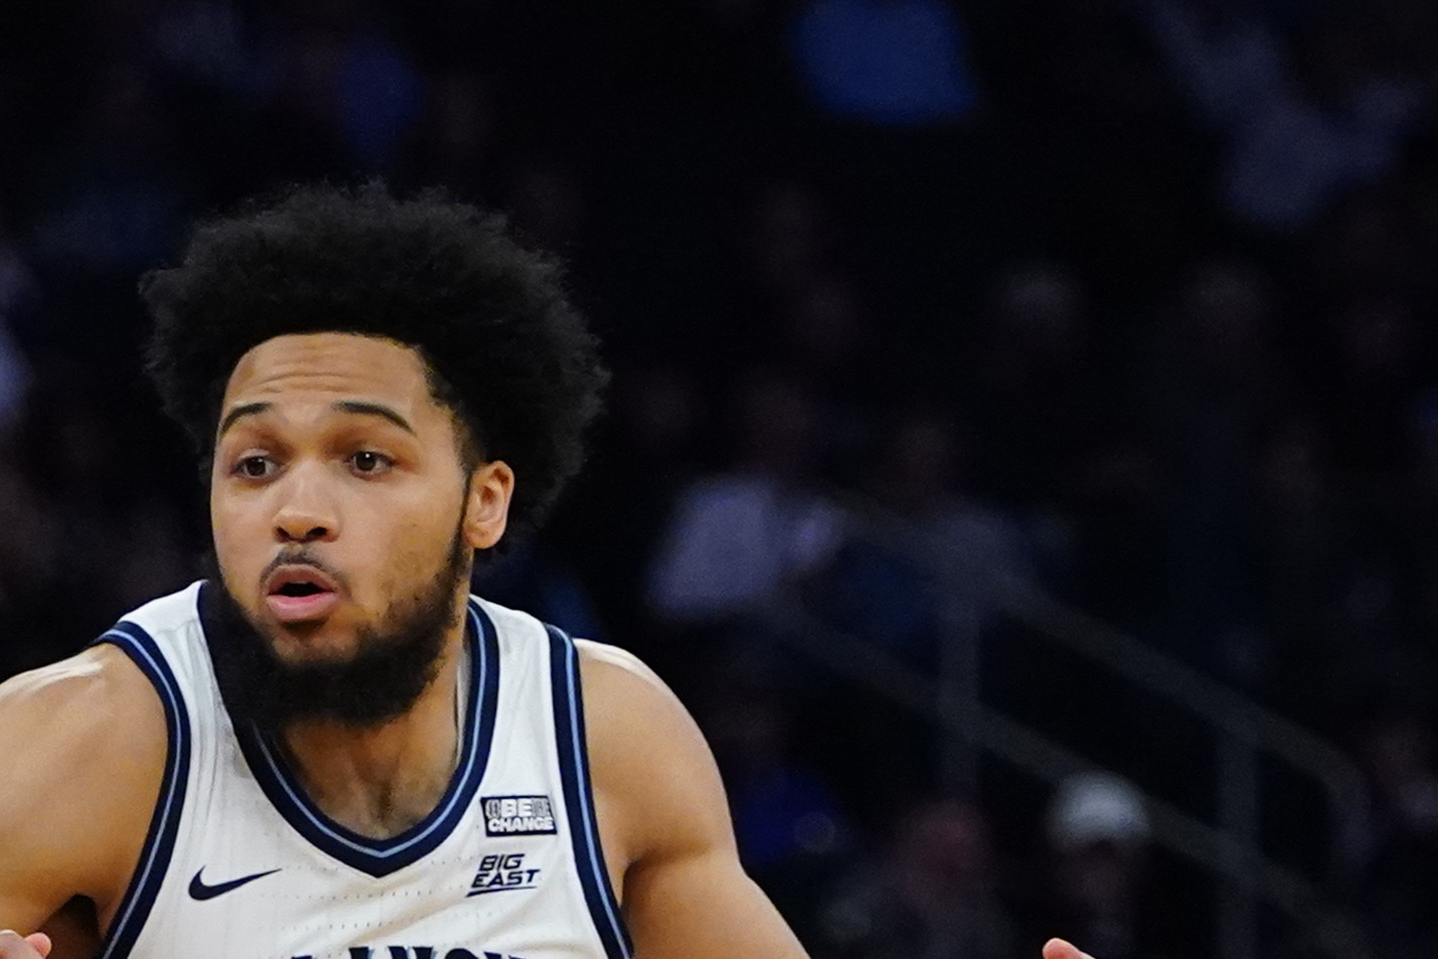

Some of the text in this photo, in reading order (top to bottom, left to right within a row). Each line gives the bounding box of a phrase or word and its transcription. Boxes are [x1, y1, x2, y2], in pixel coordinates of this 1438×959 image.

[488, 815, 555, 833] CHANGE
[479, 853, 525, 872] BIG
[471, 868, 541, 889] EAST
